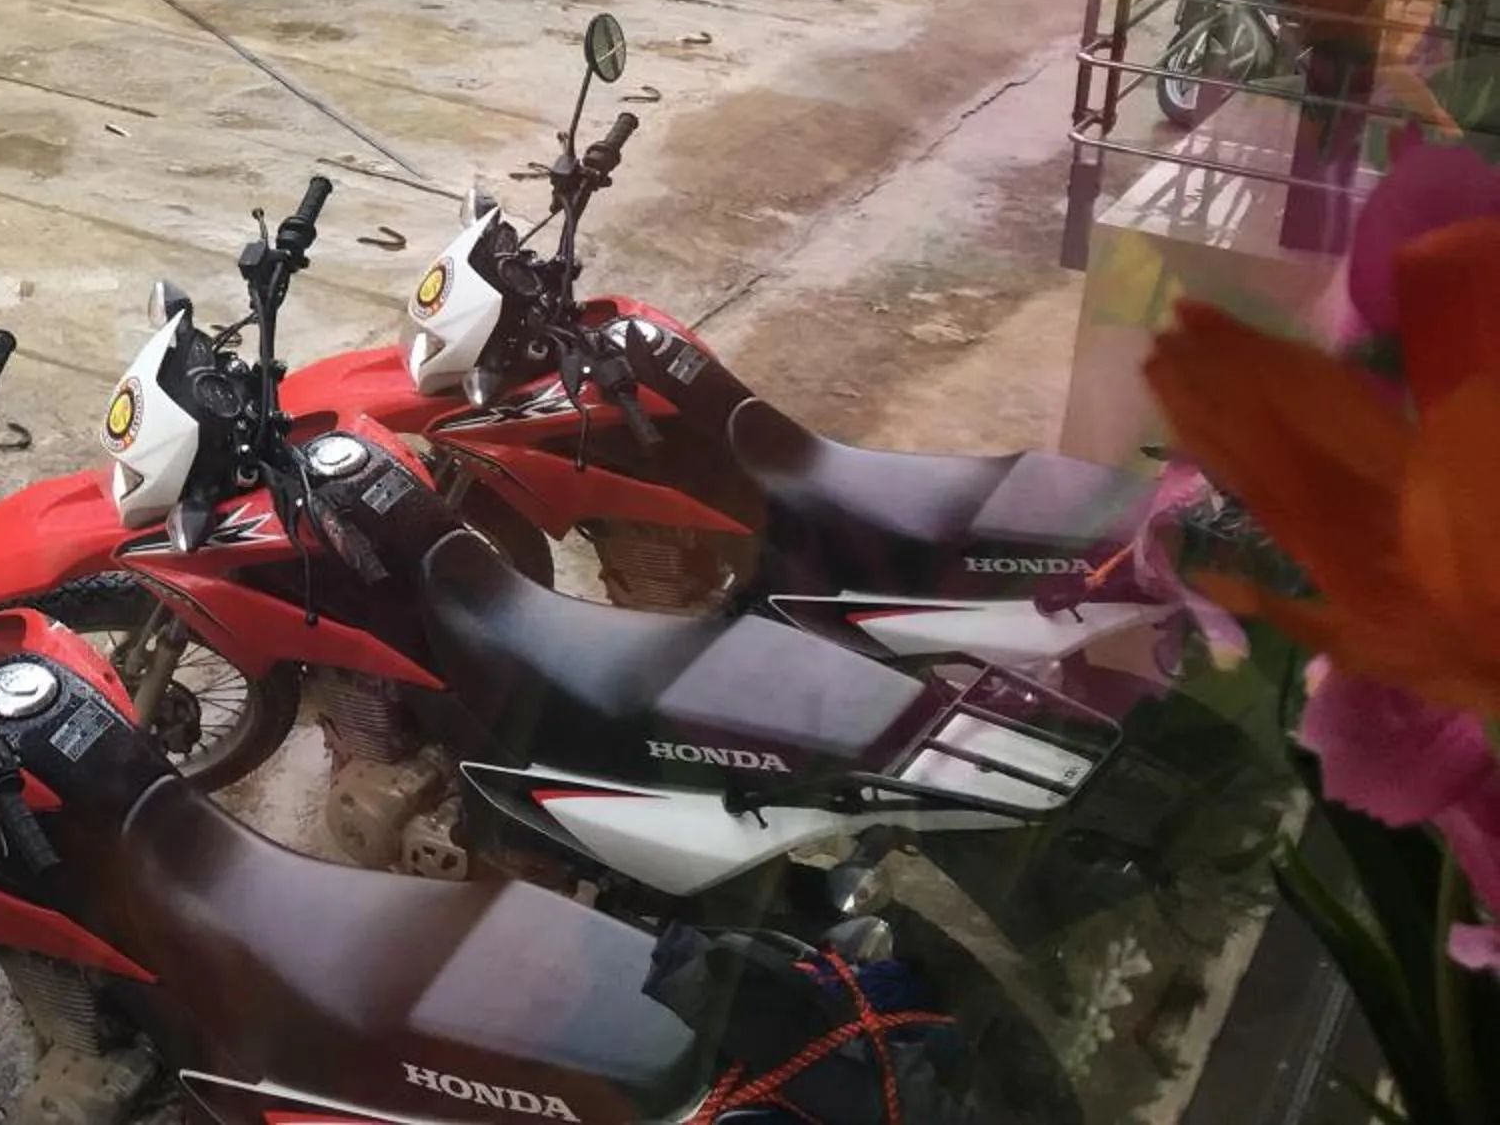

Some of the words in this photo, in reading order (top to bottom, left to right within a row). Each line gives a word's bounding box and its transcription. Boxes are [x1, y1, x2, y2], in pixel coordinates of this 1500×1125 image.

[964, 556, 1096, 574] HONDA
[645, 740, 792, 774] HONDA
[402, 1061, 581, 1123] HONDA
